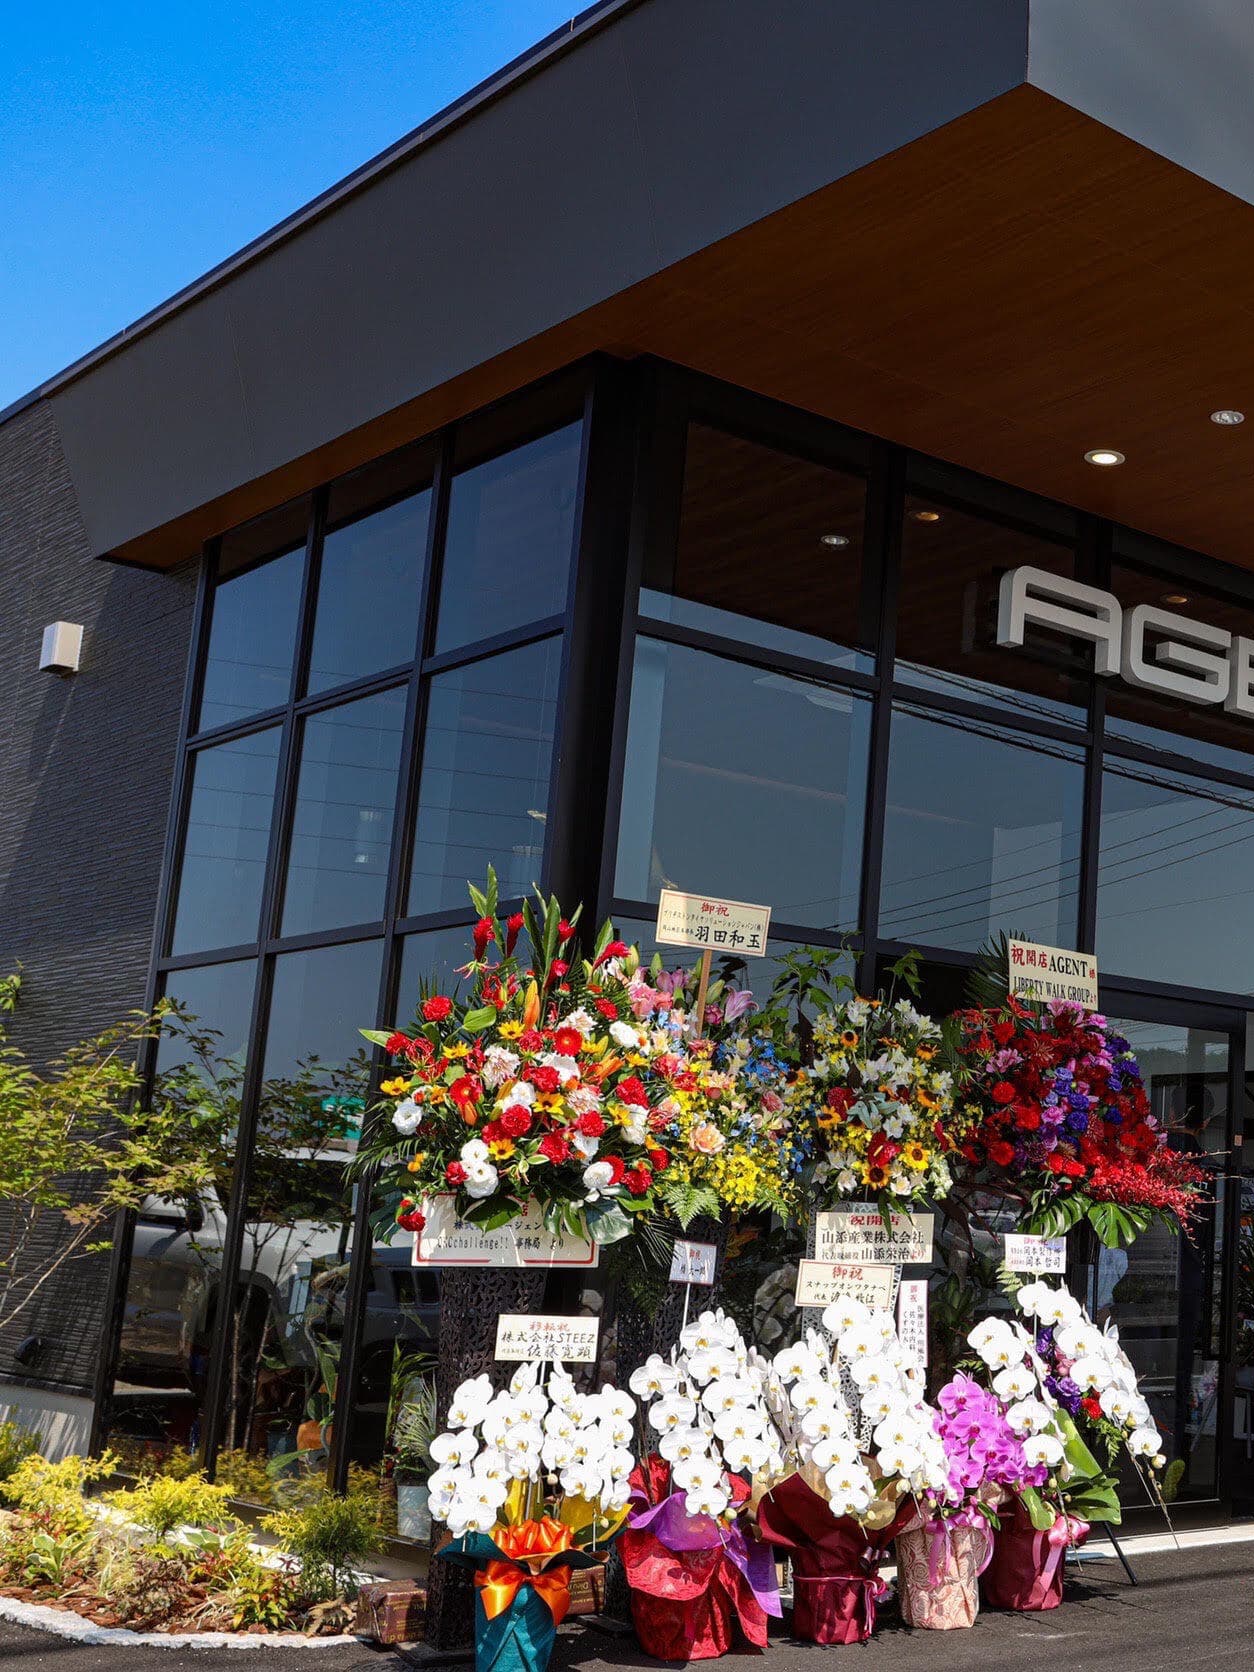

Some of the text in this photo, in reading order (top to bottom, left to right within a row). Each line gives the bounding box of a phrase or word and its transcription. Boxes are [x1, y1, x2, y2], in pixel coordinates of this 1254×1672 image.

[702, 901, 730, 917] 御祝
[1011, 943, 1048, 968] 祝開店
[1048, 955, 1088, 978] AGENT
[1046, 981, 1066, 999] WALK
[1067, 985, 1090, 1004] GROUP
[822, 1230, 924, 1244] 山添産業株式会社
[832, 1266, 863, 1280] 御祝
